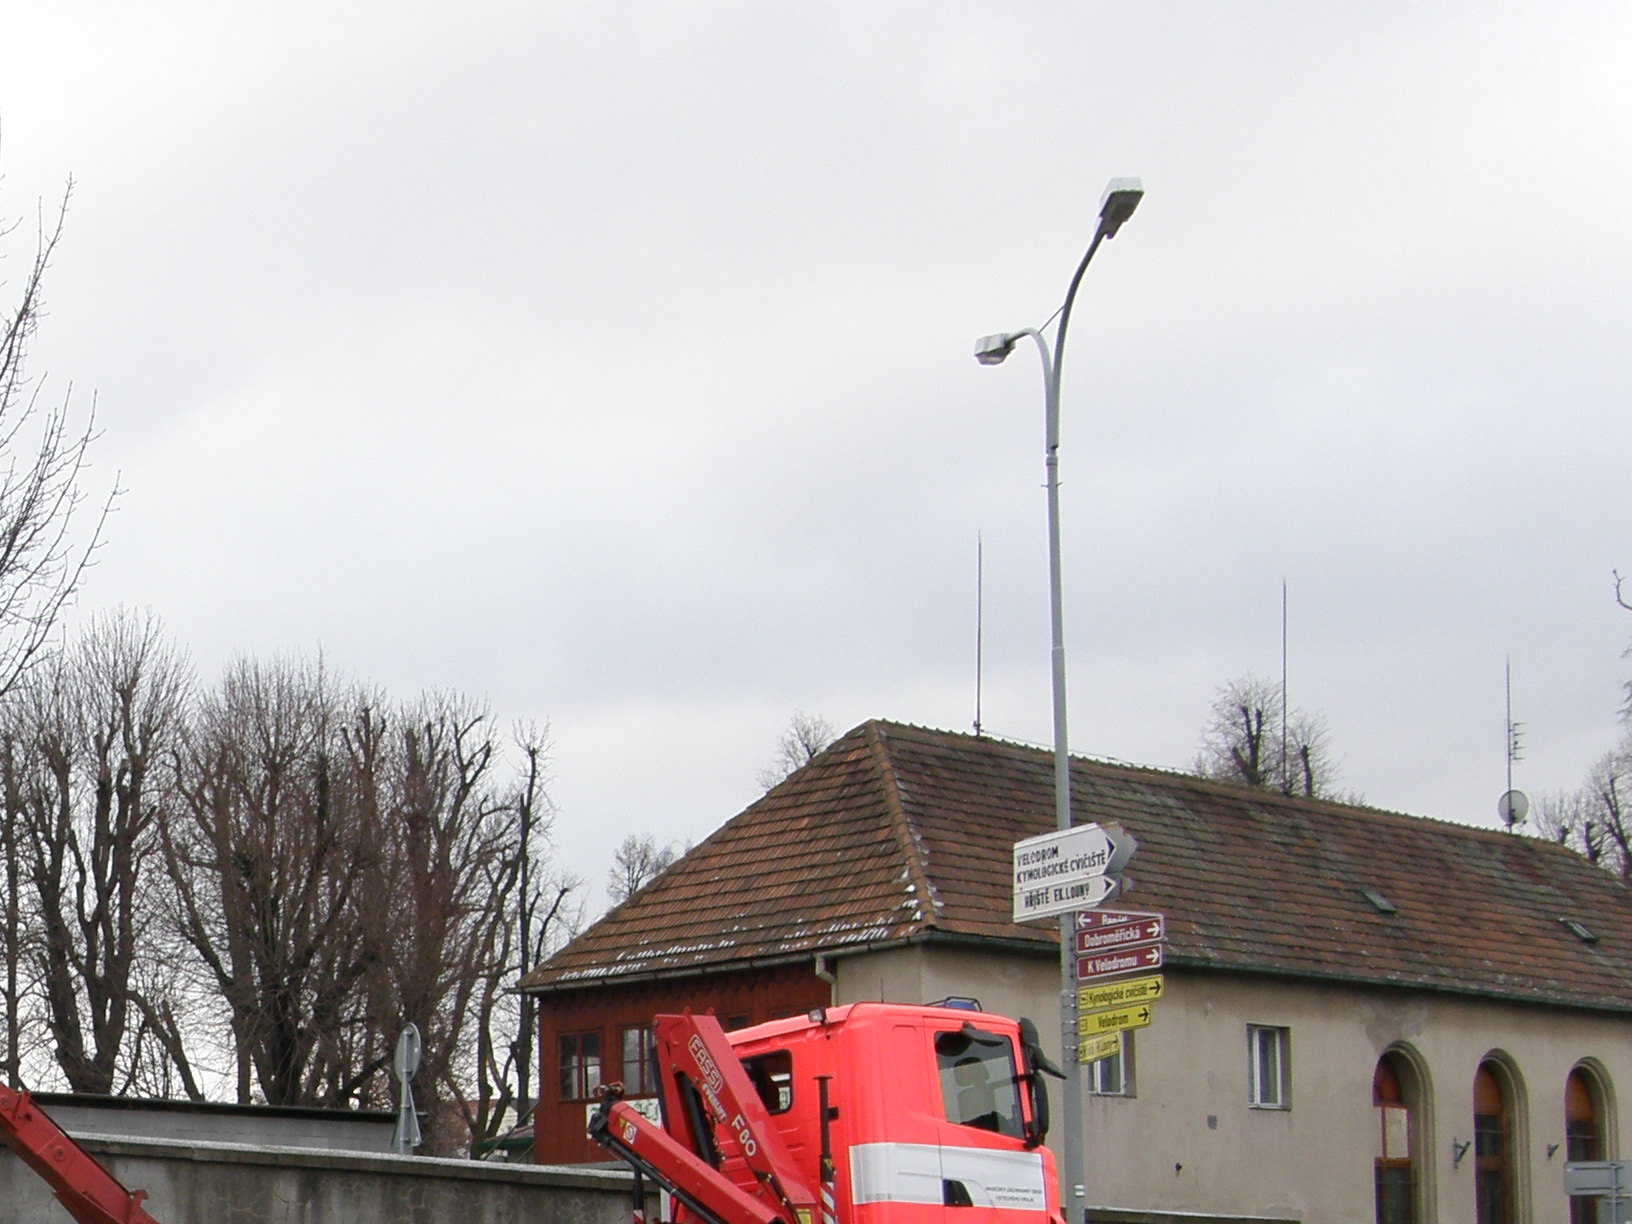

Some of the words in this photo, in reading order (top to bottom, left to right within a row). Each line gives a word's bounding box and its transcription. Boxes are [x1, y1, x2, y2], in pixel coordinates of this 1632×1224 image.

[1017, 846, 1059, 867] VELODROM
[1017, 859, 1069, 884] KYNOLOGICKÉ
[1084, 925, 1141, 948] Dobroměřická
[1087, 960, 1094, 974] K
[1095, 955, 1138, 972] Velodromu
[1097, 1012, 1129, 1029] Velodrom
[689, 1038, 722, 1093] FASSI
